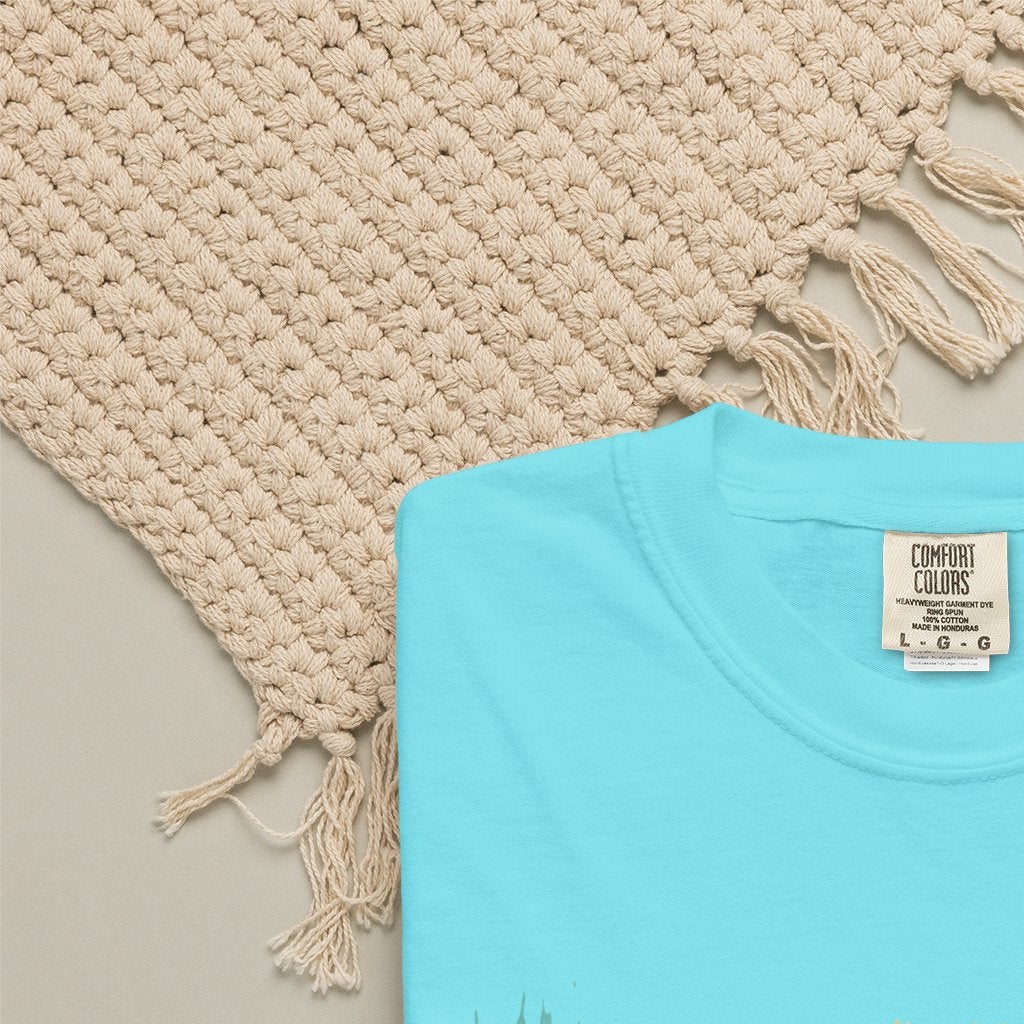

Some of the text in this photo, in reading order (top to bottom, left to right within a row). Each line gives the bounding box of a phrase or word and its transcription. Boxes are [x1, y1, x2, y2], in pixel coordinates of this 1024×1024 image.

[911, 543, 975, 568] COMFORT
[896, 598, 994, 609] HEAVYWEIGHT GARMENT DYE
[926, 608, 944, 616] RING
[922, 616, 940, 624] 100%
[912, 623, 932, 631] MADE
[941, 624, 979, 632] HONDURAS
[899, 632, 910, 648] L
[937, 635, 950, 650] G
[977, 635, 991, 651] G
